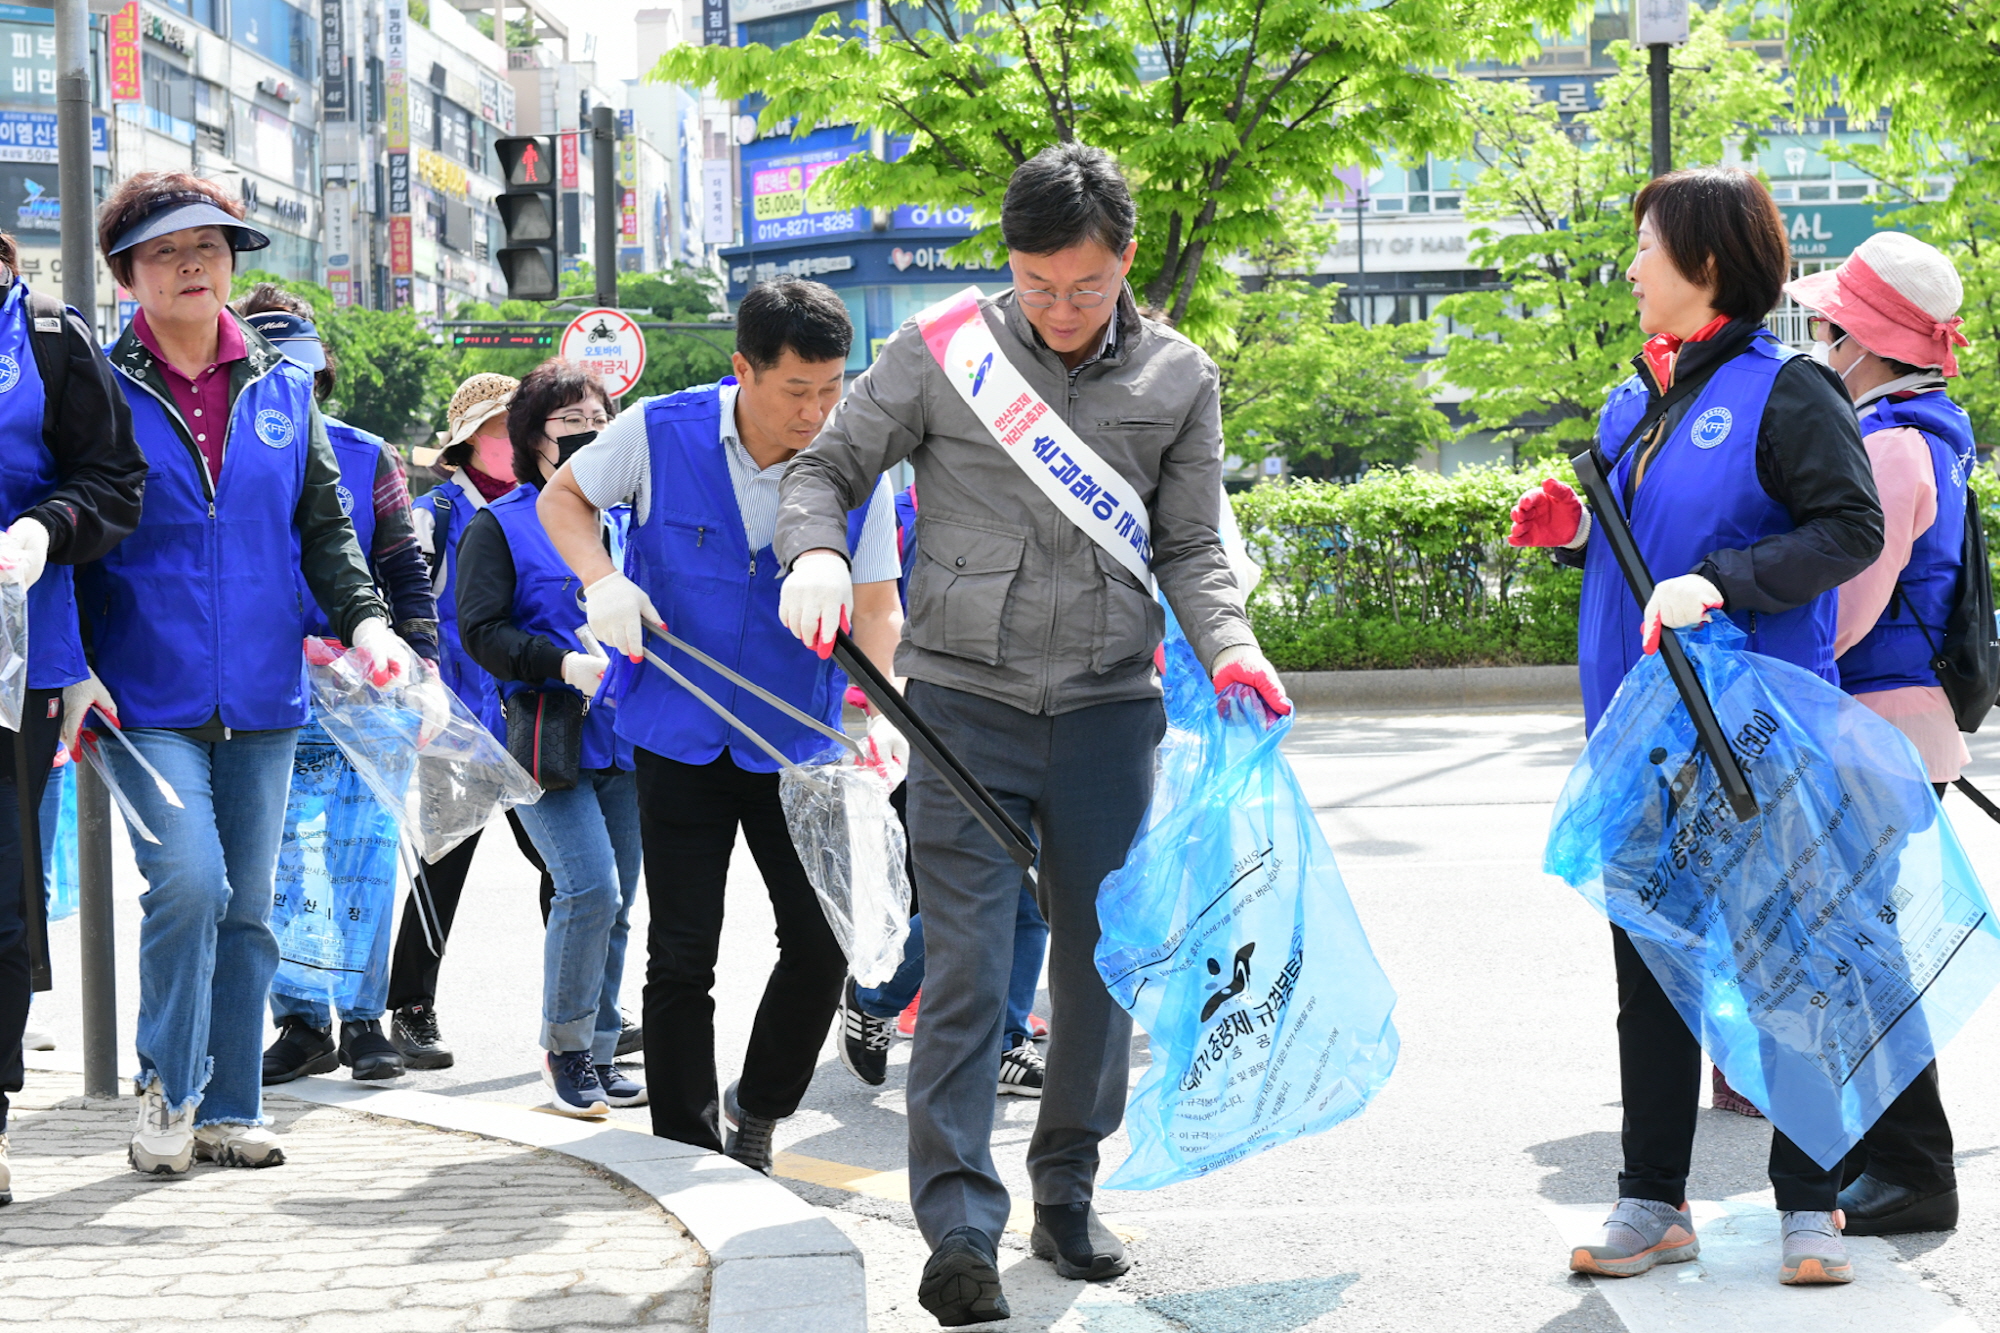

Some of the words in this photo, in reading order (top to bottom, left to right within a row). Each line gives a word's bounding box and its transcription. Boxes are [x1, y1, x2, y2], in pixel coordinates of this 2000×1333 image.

[327, 91, 342, 102] 4F
[758, 213, 854, 240] 010-8271-8295
[584, 345, 622, 356] 오토바이
[994, 392, 1032, 432] 안산국제
[1001, 402, 1048, 446] 거리극축제
[264, 422, 286, 435] KFF
[1700, 421, 1725, 434] KFF
[1032, 435, 1120, 521] 손님맞이
[274, 893, 288, 908] 안
[303, 898, 317, 914] 산
[348, 906, 361, 922] 장
[1853, 933, 1872, 951] 시
[1877, 905, 1897, 925] 장
[1210, 1010, 1253, 1060] 종량제
